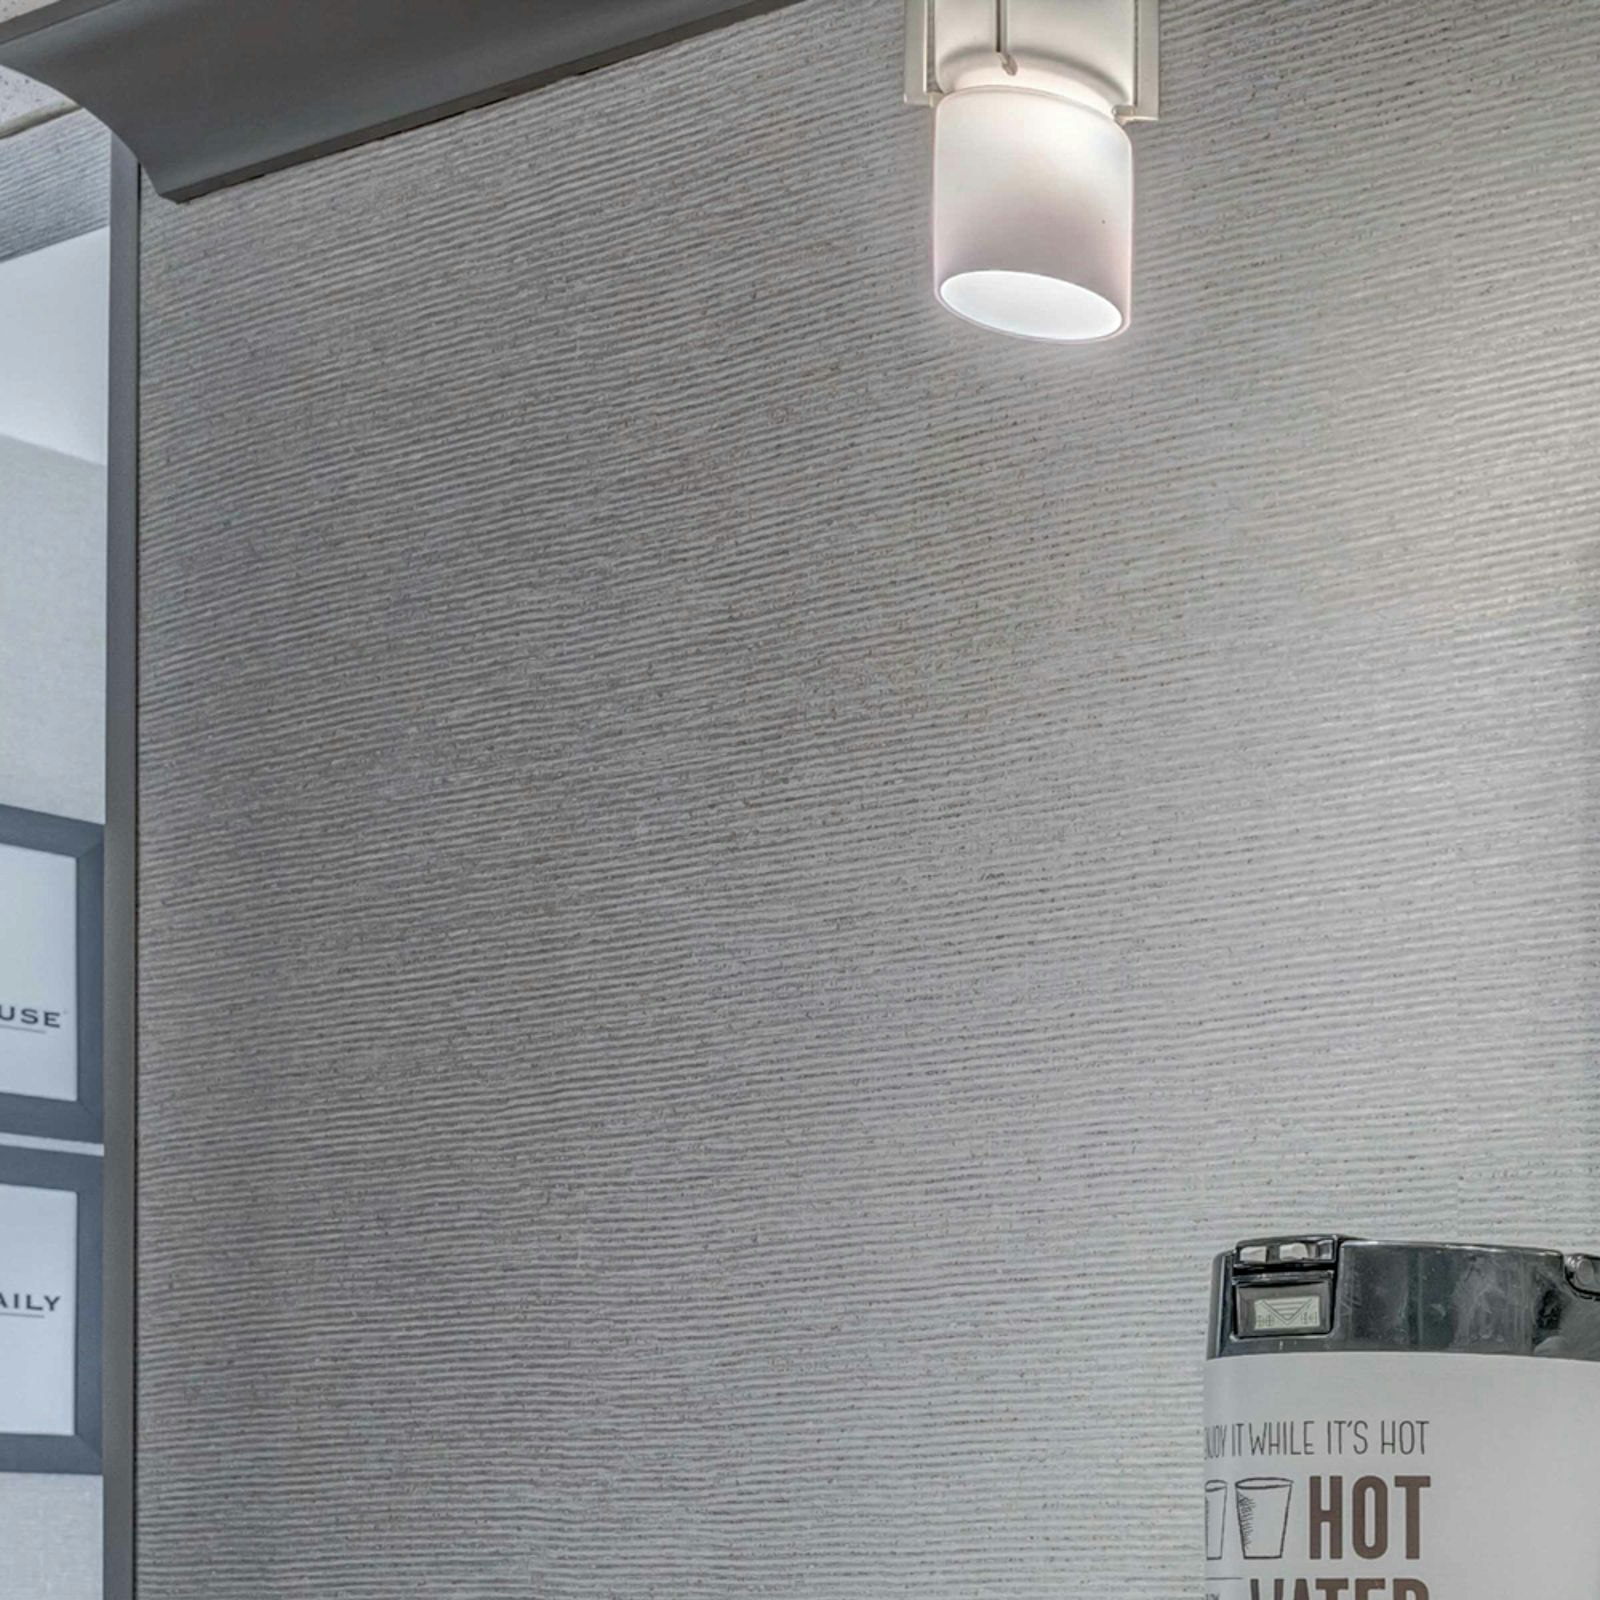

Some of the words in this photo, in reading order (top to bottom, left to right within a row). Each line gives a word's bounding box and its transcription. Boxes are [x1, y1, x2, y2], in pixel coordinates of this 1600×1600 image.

[0, 1004, 62, 1029] USE
[1230, 1423, 1245, 1457] IT
[1248, 1420, 1316, 1456] WHILE
[1327, 1420, 1369, 1455] IT'S
[1380, 1420, 1431, 1455] HOT
[1308, 1475, 1432, 1560] HOT
